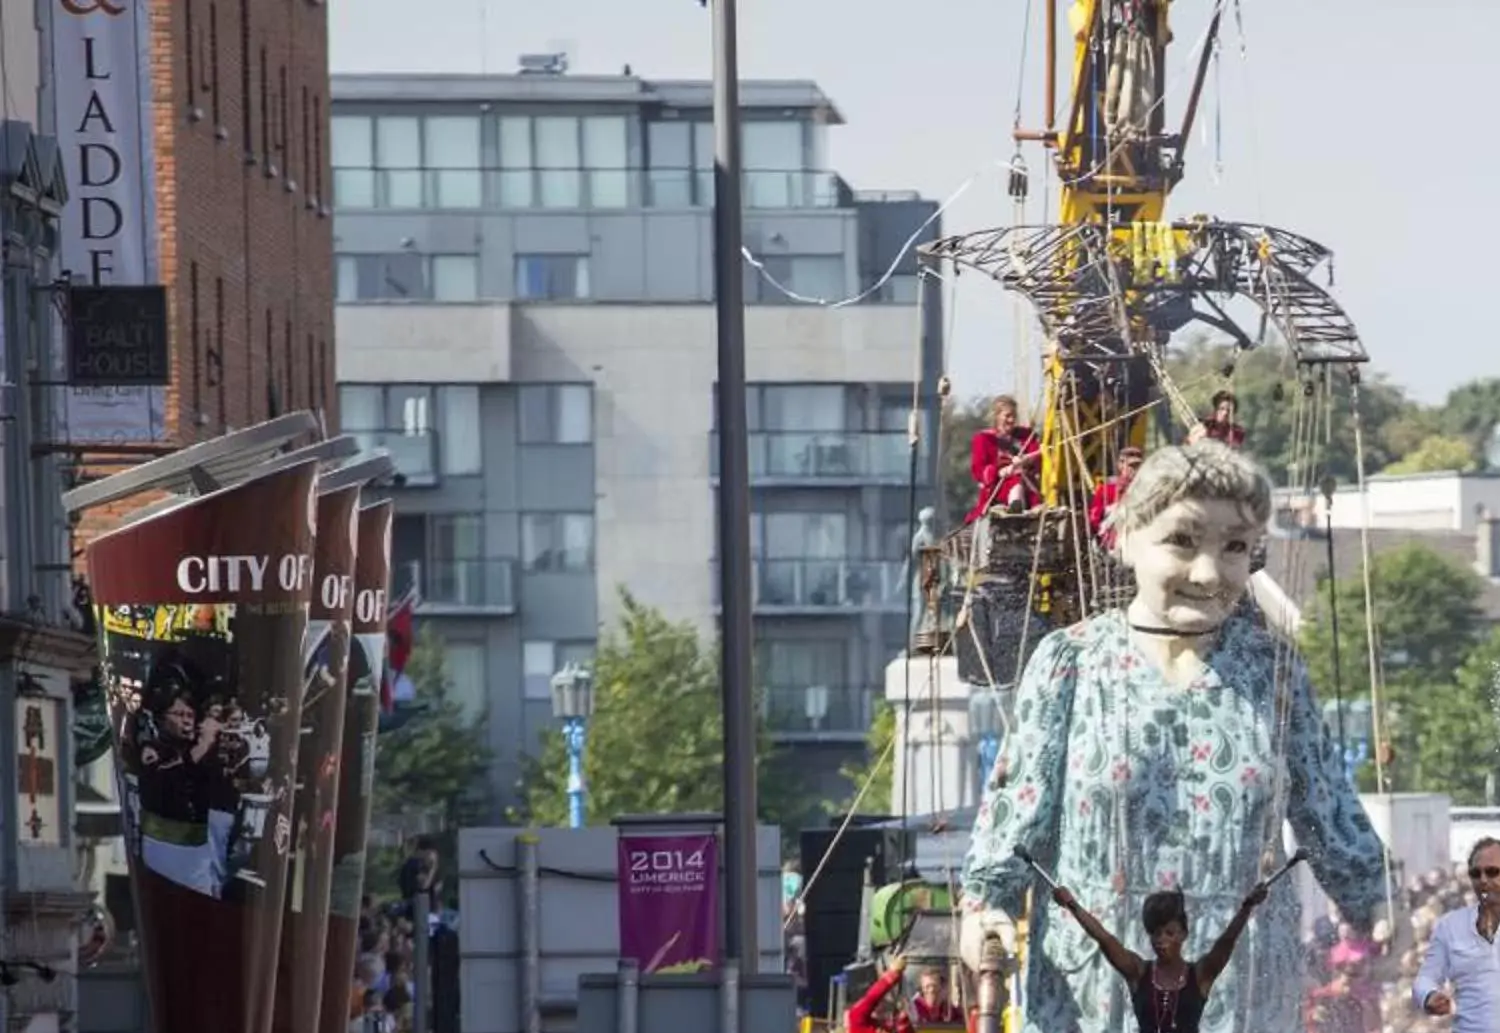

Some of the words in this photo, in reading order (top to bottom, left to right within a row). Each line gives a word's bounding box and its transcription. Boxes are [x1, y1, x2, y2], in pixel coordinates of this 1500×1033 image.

[75, 352, 162, 376] HOUSE
[176, 555, 269, 594] CITY
[278, 553, 310, 590] OF
[321, 573, 350, 609] OF
[356, 588, 386, 623] OF
[631, 850, 705, 871] 2014
[631, 871, 705, 884] LIMERICK
